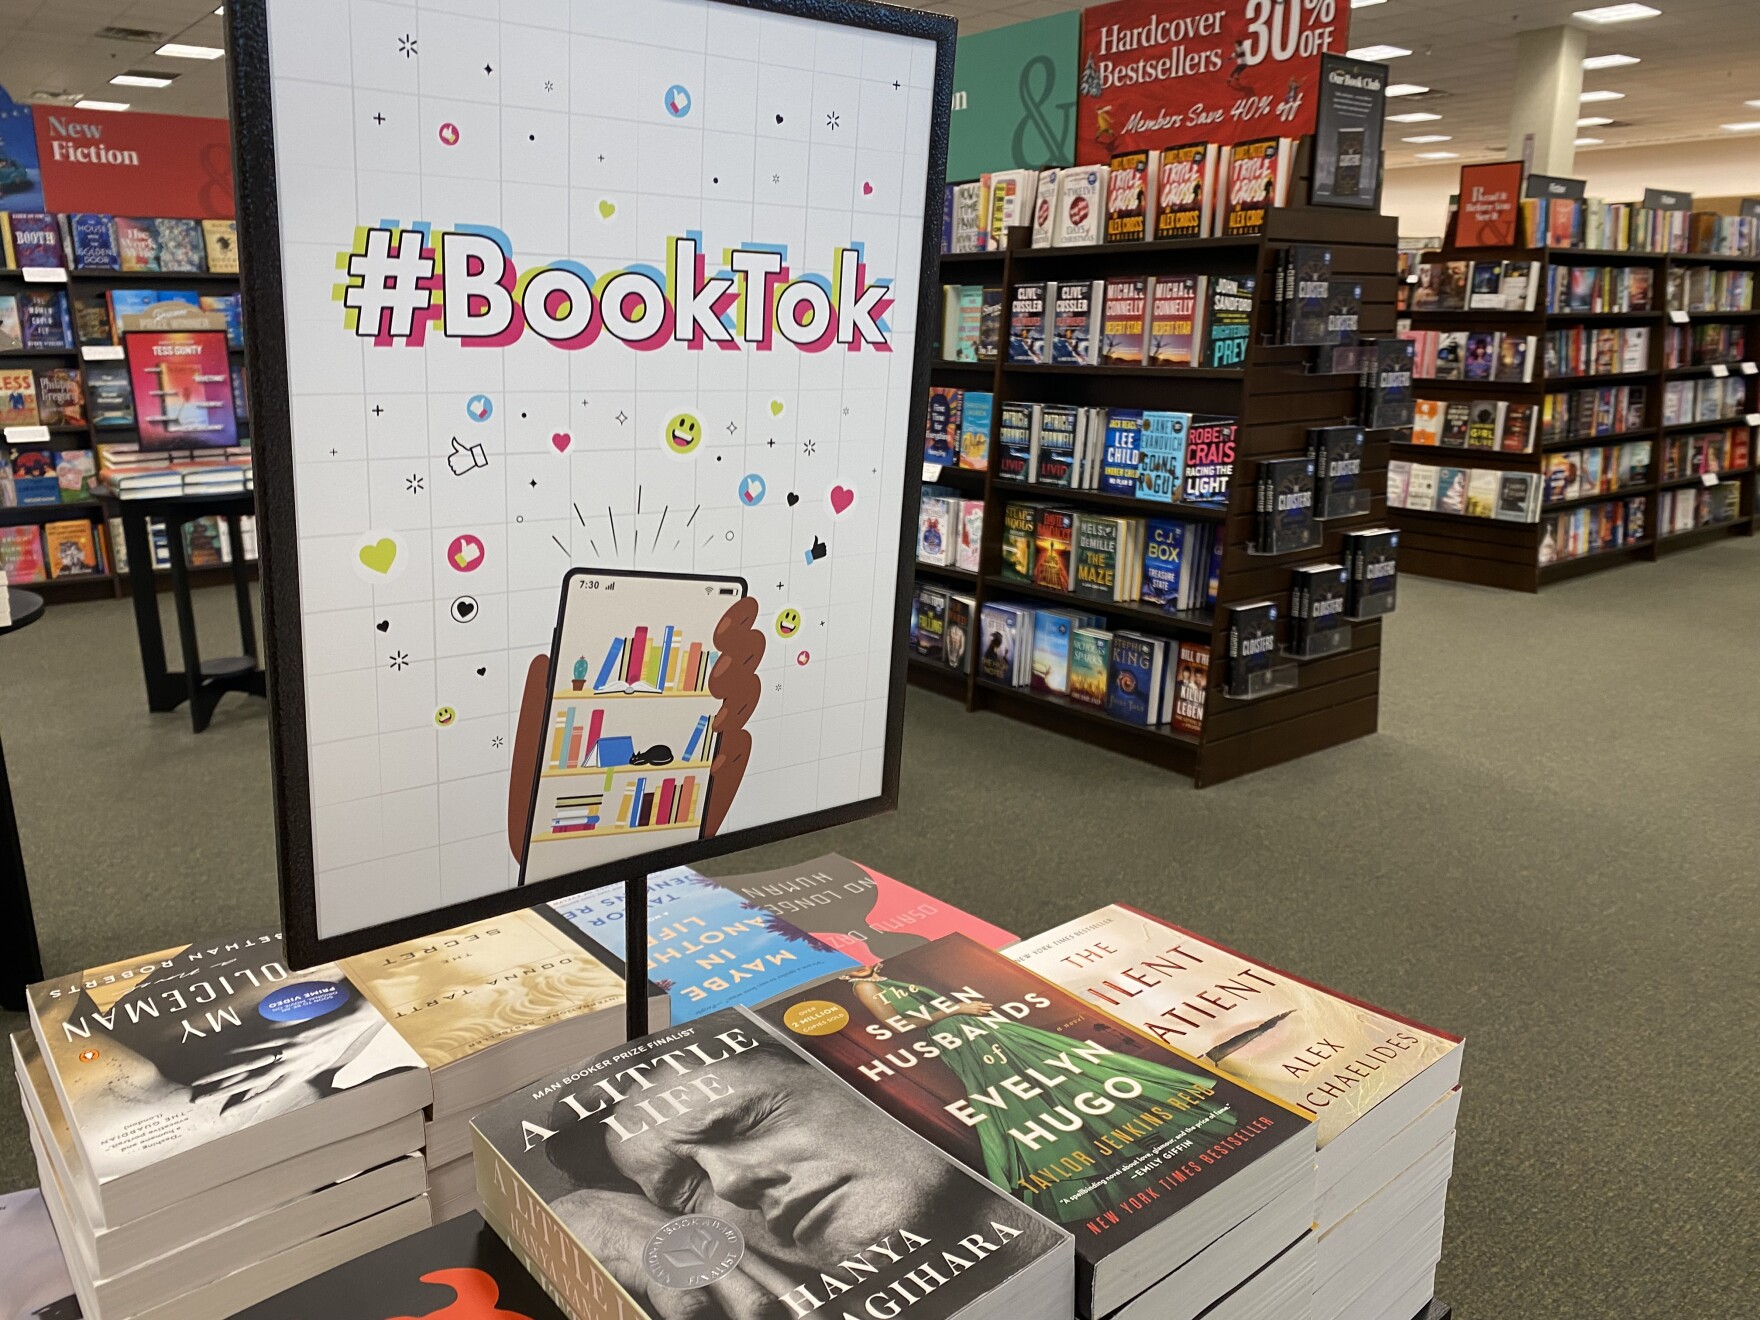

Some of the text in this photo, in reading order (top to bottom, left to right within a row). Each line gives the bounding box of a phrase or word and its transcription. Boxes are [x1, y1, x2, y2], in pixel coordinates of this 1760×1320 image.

[1098, 10, 1226, 55] Hardcover
[1299, 27, 1334, 59] OFF
[1099, 46, 1223, 88] Bestsellers
[1121, 110, 1184, 134] Members
[1185, 103, 1224, 127] Save
[1230, 95, 1274, 121] 40%
[1275, 93, 1304, 122] off
[48, 115, 103, 139] New
[51, 140, 140, 166] Fiction
[15, 231, 56, 245] BOOTH
[335, 220, 894, 351] #BookTok
[1017, 287, 1038, 300] CLIVE
[1061, 286, 1083, 300] CLIVE
[1215, 278, 1239, 294] JOHN
[1012, 300, 1043, 313] CUSSLER
[1056, 300, 1088, 313] CUSSLER
[1106, 300, 1144, 315] CONNELLY
[1154, 300, 1195, 316] CONNELLY
[1214, 295, 1253, 311] SANDFORD
[1213, 338, 1249, 368] PREY
[1150, 419, 1176, 435] JANET
[1115, 431, 1135, 448] LEE
[1141, 434, 1183, 452] EVANOVICH
[1107, 447, 1140, 465] CHILD
[1186, 442, 1236, 465] CRAIS
[1185, 465, 1233, 477] RACING THE
[1187, 477, 1229, 495] LIGHT
[1087, 552, 1105, 566] THE
[1148, 543, 1179, 563] BOX
[579, 580, 600, 591] 7:30
[1078, 565, 1114, 586] MAZE
[1148, 567, 1175, 582] TREASURE
[1152, 578, 1169, 592] STATE
[1242, 635, 1274, 656] CLOISTERS
[1112, 648, 1150, 669] KING
[741, 872, 833, 898] HUMAN
[764, 876, 877, 915] NO LONGE
[383, 928, 501, 966] SECRET
[1033, 944, 1052, 956] YORK
[1052, 934, 1074, 946] TIMES
[1073, 918, 1114, 937] BESTSELLER
[440, 952, 473, 965] THE
[695, 949, 737, 970] IN
[1059, 942, 1118, 968] THE
[49, 959, 174, 1000] ROBERTS
[679, 949, 798, 1002] MAYBE
[1086, 944, 1205, 1006] ILENT
[268, 986, 336, 1009] PRIME VIDEO
[394, 958, 573, 1019] DONNA TARTT
[872, 982, 920, 1006] The
[61, 962, 288, 1043] OLICEMAN
[865, 985, 985, 1041] SEVEN
[1142, 968, 1278, 1045] ATIENT
[181, 1006, 242, 1044] MY
[791, 1005, 839, 1029] 2 MILLION
[801, 1012, 845, 1033] COPIES SOLD
[857, 992, 1051, 1082] HUSBANDS
[532, 1027, 696, 1100] MAN BOOKER PRIZE FINALIST
[982, 1043, 1009, 1066] of
[1281, 1037, 1346, 1079] ALEX
[943, 1039, 1115, 1128] EVELYN
[1296, 1032, 1419, 1116] ICHAELIDES
[520, 1027, 760, 1153] A LITTLE
[599, 1073, 735, 1143] LIFE
[1007, 1076, 1144, 1151] HUGO
[100, 1121, 160, 1146] GUARDIAN
[1018, 1150, 1097, 1195] TAYLOR
[1093, 1106, 1174, 1156] JENKINS
[1070, 1178, 1107, 1201] spellbinding
[1106, 1168, 1123, 1182] novel
[1121, 1158, 1139, 1172] about
[1175, 1130, 1188, 1140] and
[1185, 1124, 1197, 1134] the
[1195, 1118, 1210, 1129] price
[1208, 1112, 1216, 1120] of
[1164, 1139, 1194, 1160] GIFFIN
[1085, 1115, 1275, 1236] NEW YORK TIMES BESTSELLER
[778, 1228, 932, 1320] HANYA
